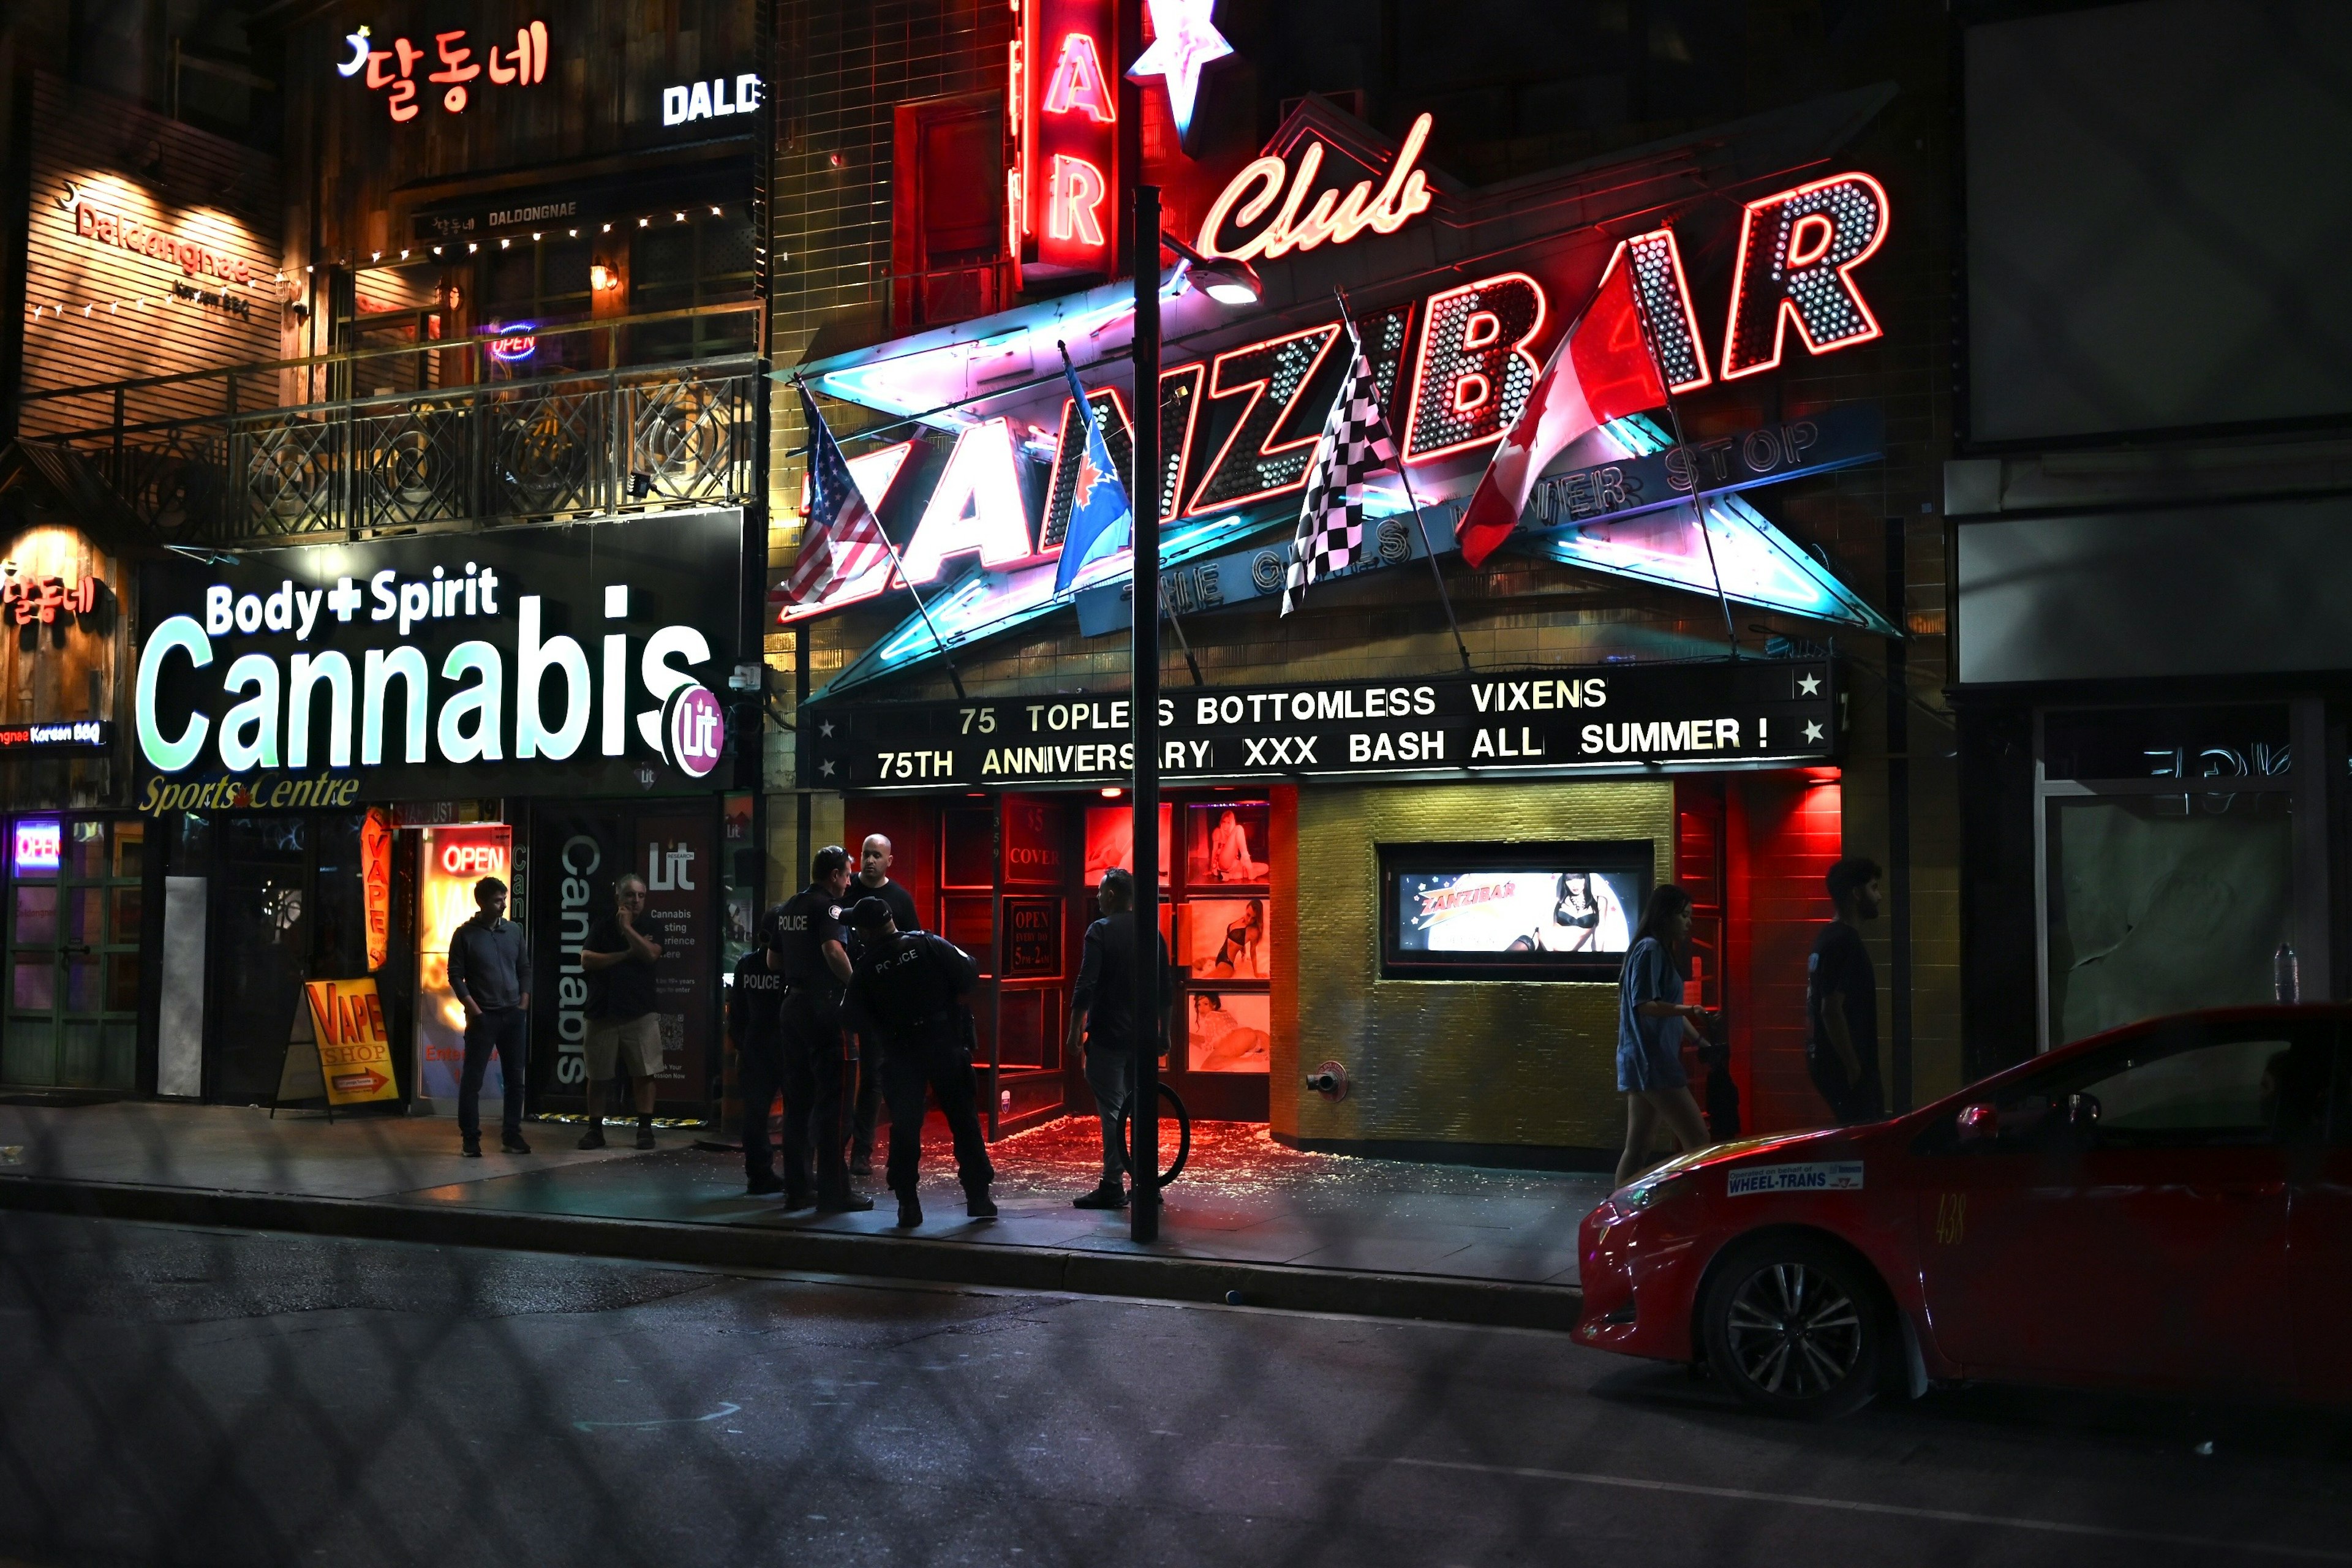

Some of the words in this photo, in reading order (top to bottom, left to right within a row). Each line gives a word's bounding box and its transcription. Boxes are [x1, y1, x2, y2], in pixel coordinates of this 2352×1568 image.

[367, 20, 548, 123] 달동네
[1198, 112, 1433, 261] Club
[437, 217, 475, 236] 달동네
[489, 202, 576, 227] DALDONGNAE
[76, 201, 251, 282] Daldongnae
[492, 336, 535, 353] OPEN
[1665, 421, 1819, 491] STOP
[3, 575, 94, 625] 달동네
[206, 581, 324, 640] Body
[371, 562, 498, 635] Spirit
[135, 585, 710, 771] Cannabis
[960, 708, 996, 734] 75
[1026, 699, 1174, 733] TOPLES
[1197, 685, 1436, 725] BOTTOMLESS
[1471, 678, 1607, 713] VIXENS
[878, 749, 953, 779] 75TH
[982, 740, 1209, 775] ANNIVERSRY
[1244, 736, 1318, 767] XXX
[1349, 730, 1444, 763] BASH
[1471, 726, 1544, 758] ALL
[1581, 718, 1741, 754] SUMMER
[139, 774, 239, 817] Sports
[249, 771, 360, 809] Centre
[20, 834, 63, 858] OPEN
[443, 845, 503, 873] OPEN
[1010, 847, 1059, 865] COVER
[367, 834, 389, 935] VAPE
[1421, 883, 1516, 914] ZANZIBAR
[650, 909, 692, 919] Cannabis
[778, 915, 808, 931] POLICE
[1015, 910, 1049, 929] OPEN
[664, 922, 687, 934] sting
[1016, 932, 1035, 942] EVERY
[743, 974, 780, 990] POLICE
[307, 982, 388, 1046] VAPE
[323, 1045, 386, 1065] SHOP
[1729, 1172, 1826, 1194] WHEEL-TRANS
[1730, 1169, 1764, 1180] Operated
[1777, 1166, 1802, 1175] behalf
